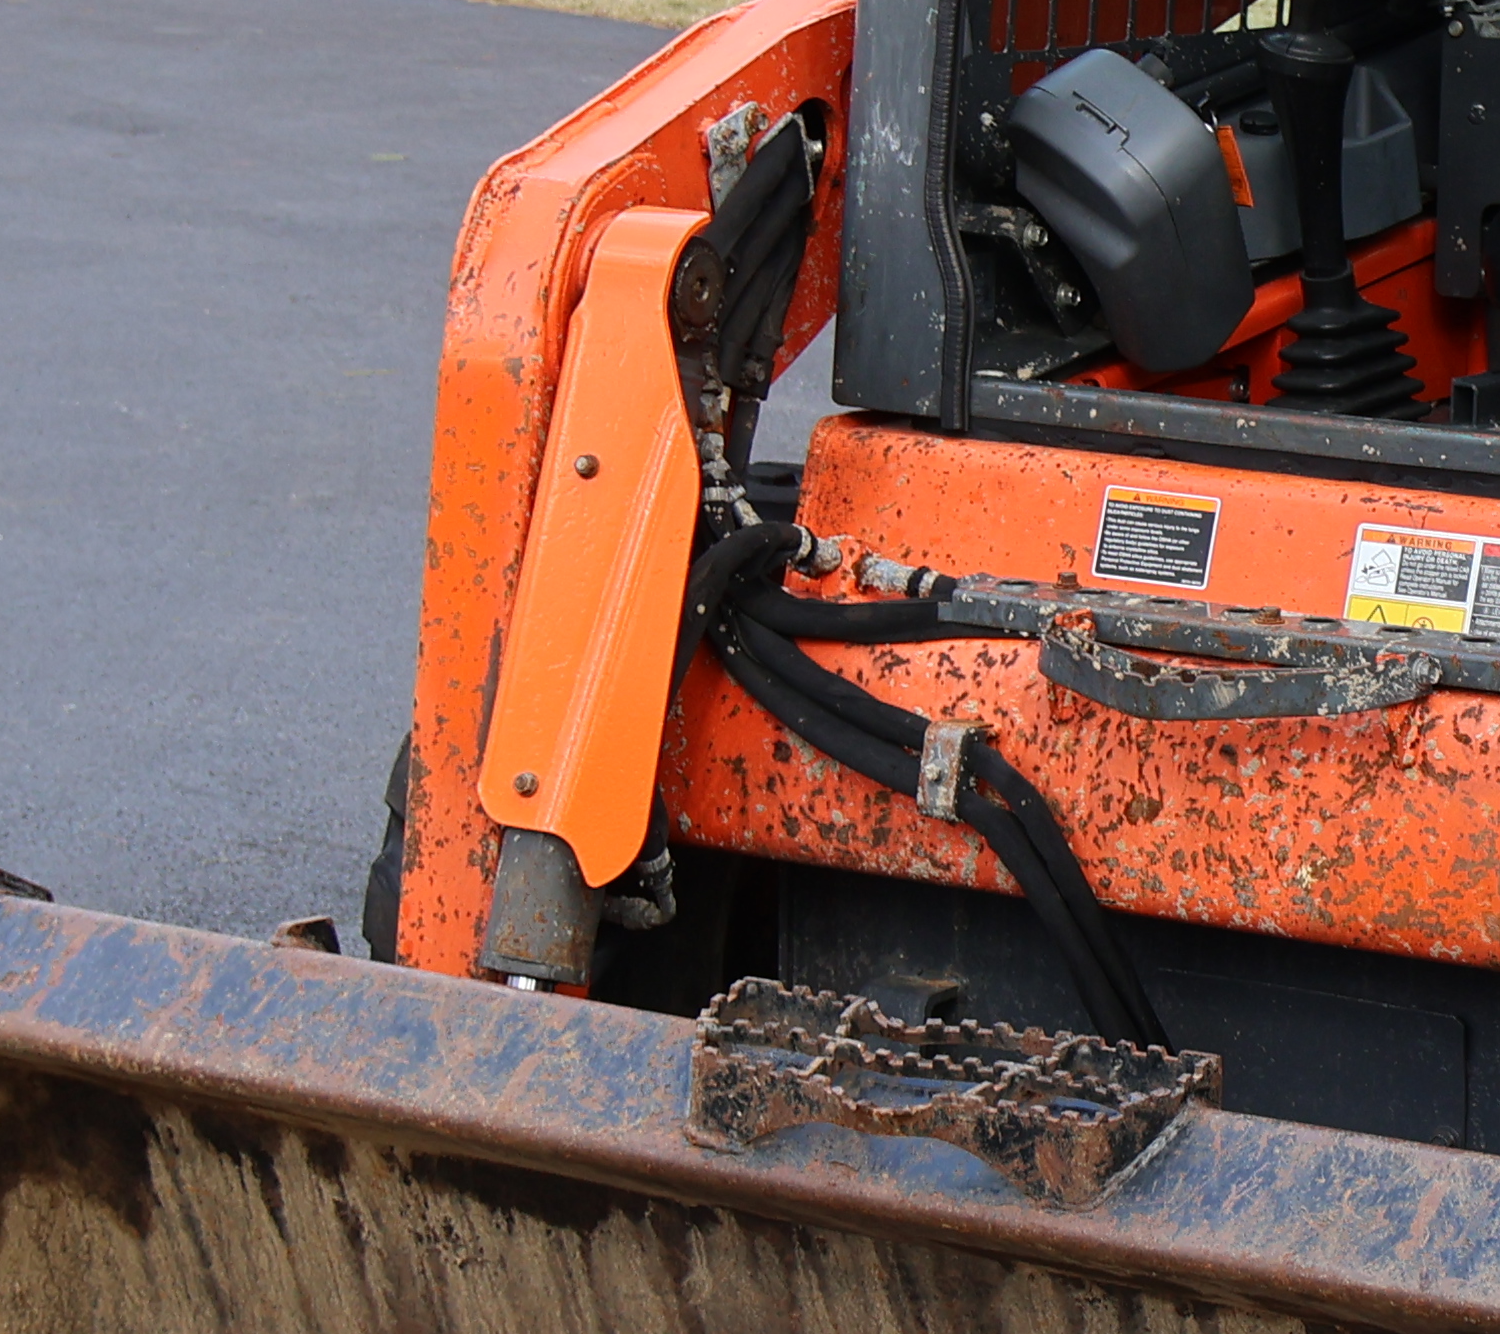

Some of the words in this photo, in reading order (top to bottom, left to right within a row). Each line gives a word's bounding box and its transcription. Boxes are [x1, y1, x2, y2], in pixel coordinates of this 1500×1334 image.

[1145, 495, 1185, 506] WARNING
[1398, 536, 1452, 550] WARNING
[1413, 548, 1432, 556] AVOID
[1434, 550, 1466, 560] PERSONAL
